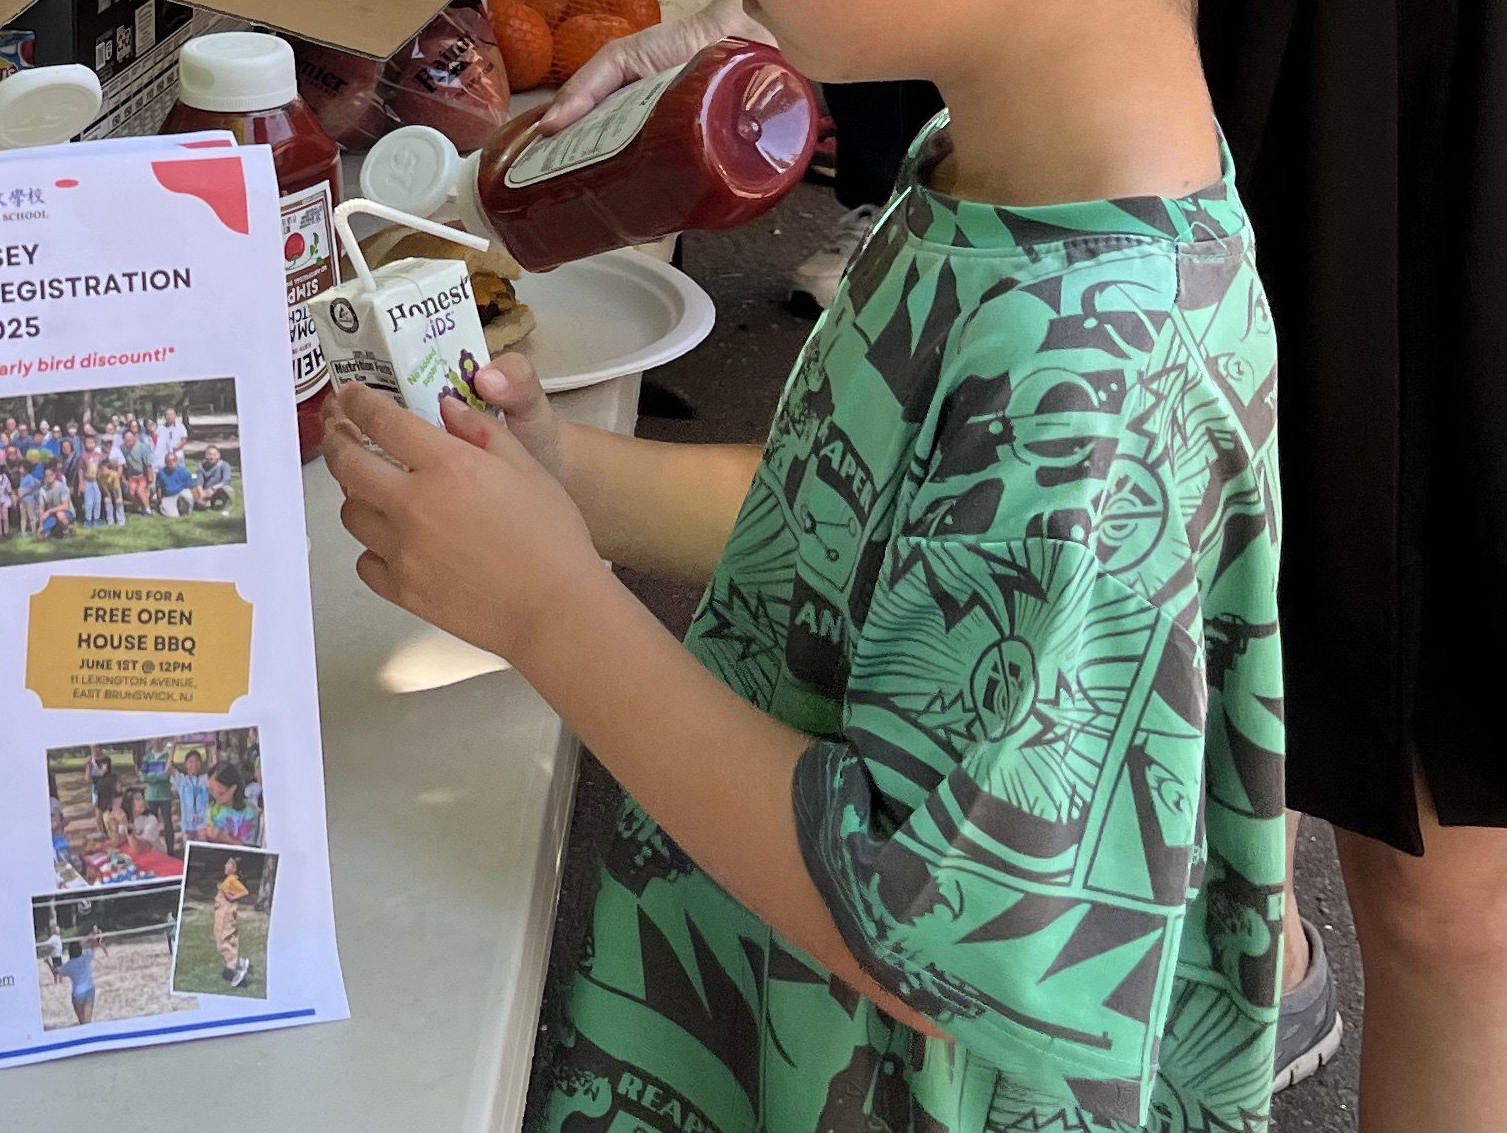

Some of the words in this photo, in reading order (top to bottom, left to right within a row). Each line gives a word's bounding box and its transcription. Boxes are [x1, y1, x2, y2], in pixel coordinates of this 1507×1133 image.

[2, 210, 49, 222] SCHOOL
[386, 275, 472, 333] Honest
[38, 356, 75, 372] bird
[90, 588, 121, 600] JOIN
[126, 590, 142, 601] US
[146, 590, 172, 602] FOR
[84, 607, 131, 624] FREE
[138, 609, 192, 625] OPEN
[78, 633, 147, 650] HOUSE
[154, 635, 195, 656] BBQ
[79, 658, 112, 670] JUNE
[117, 660, 139, 670] 1ST
[159, 661, 191, 673] 12PM
